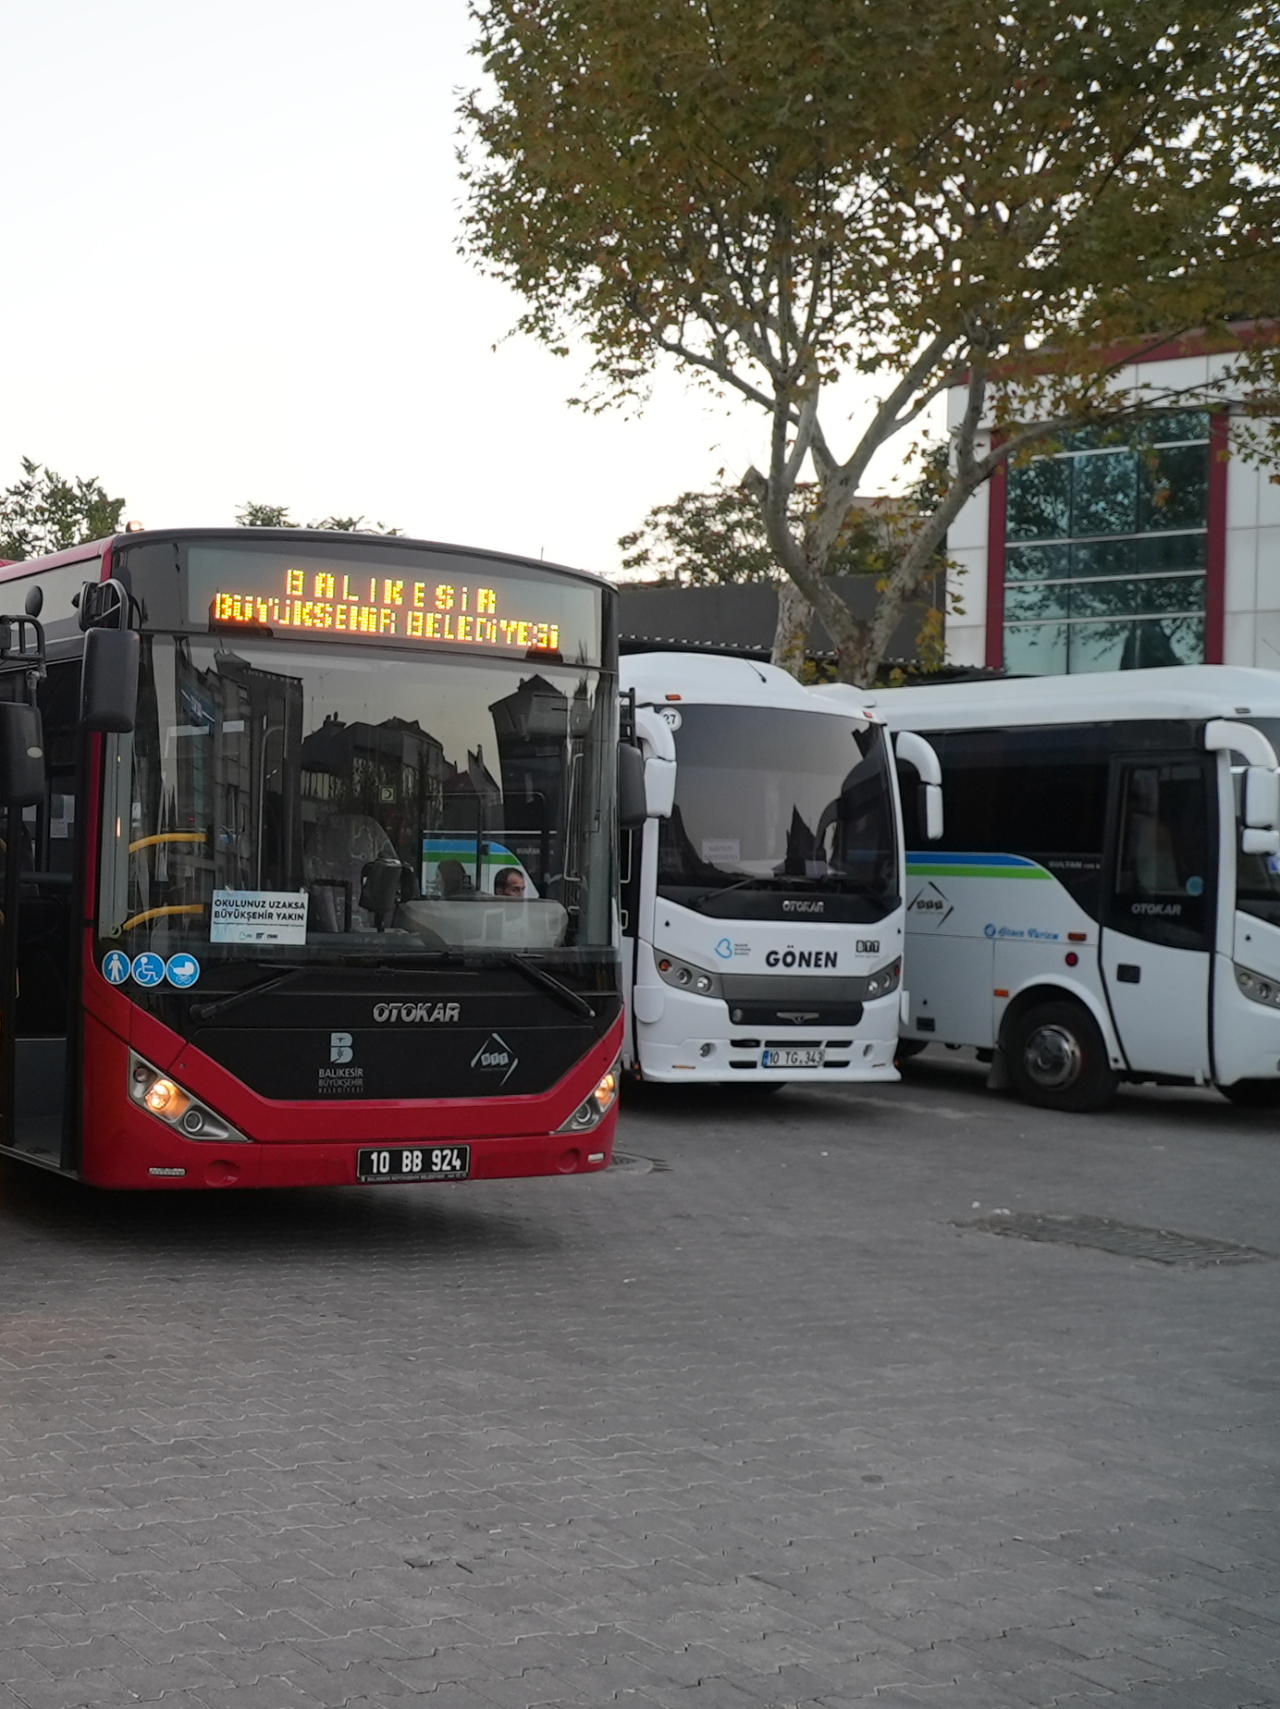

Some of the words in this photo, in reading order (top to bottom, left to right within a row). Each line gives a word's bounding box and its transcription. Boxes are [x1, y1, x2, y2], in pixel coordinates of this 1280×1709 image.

[214, 899, 267, 909] OKULUNUZ
[269, 900, 306, 910] UZAKSA
[1131, 903, 1182, 916] OTOKAR
[214, 908, 274, 922] BÜYÜKŞEHİR
[276, 912, 304, 921] YAKIN
[765, 945, 838, 968] GÖNEN
[373, 1003, 461, 1022] OTOKAR
[318, 1067, 364, 1078] BALIKESİR
[370, 1151, 390, 1174] 10
[401, 1150, 423, 1172] BB
[431, 1149, 461, 1171] 924
